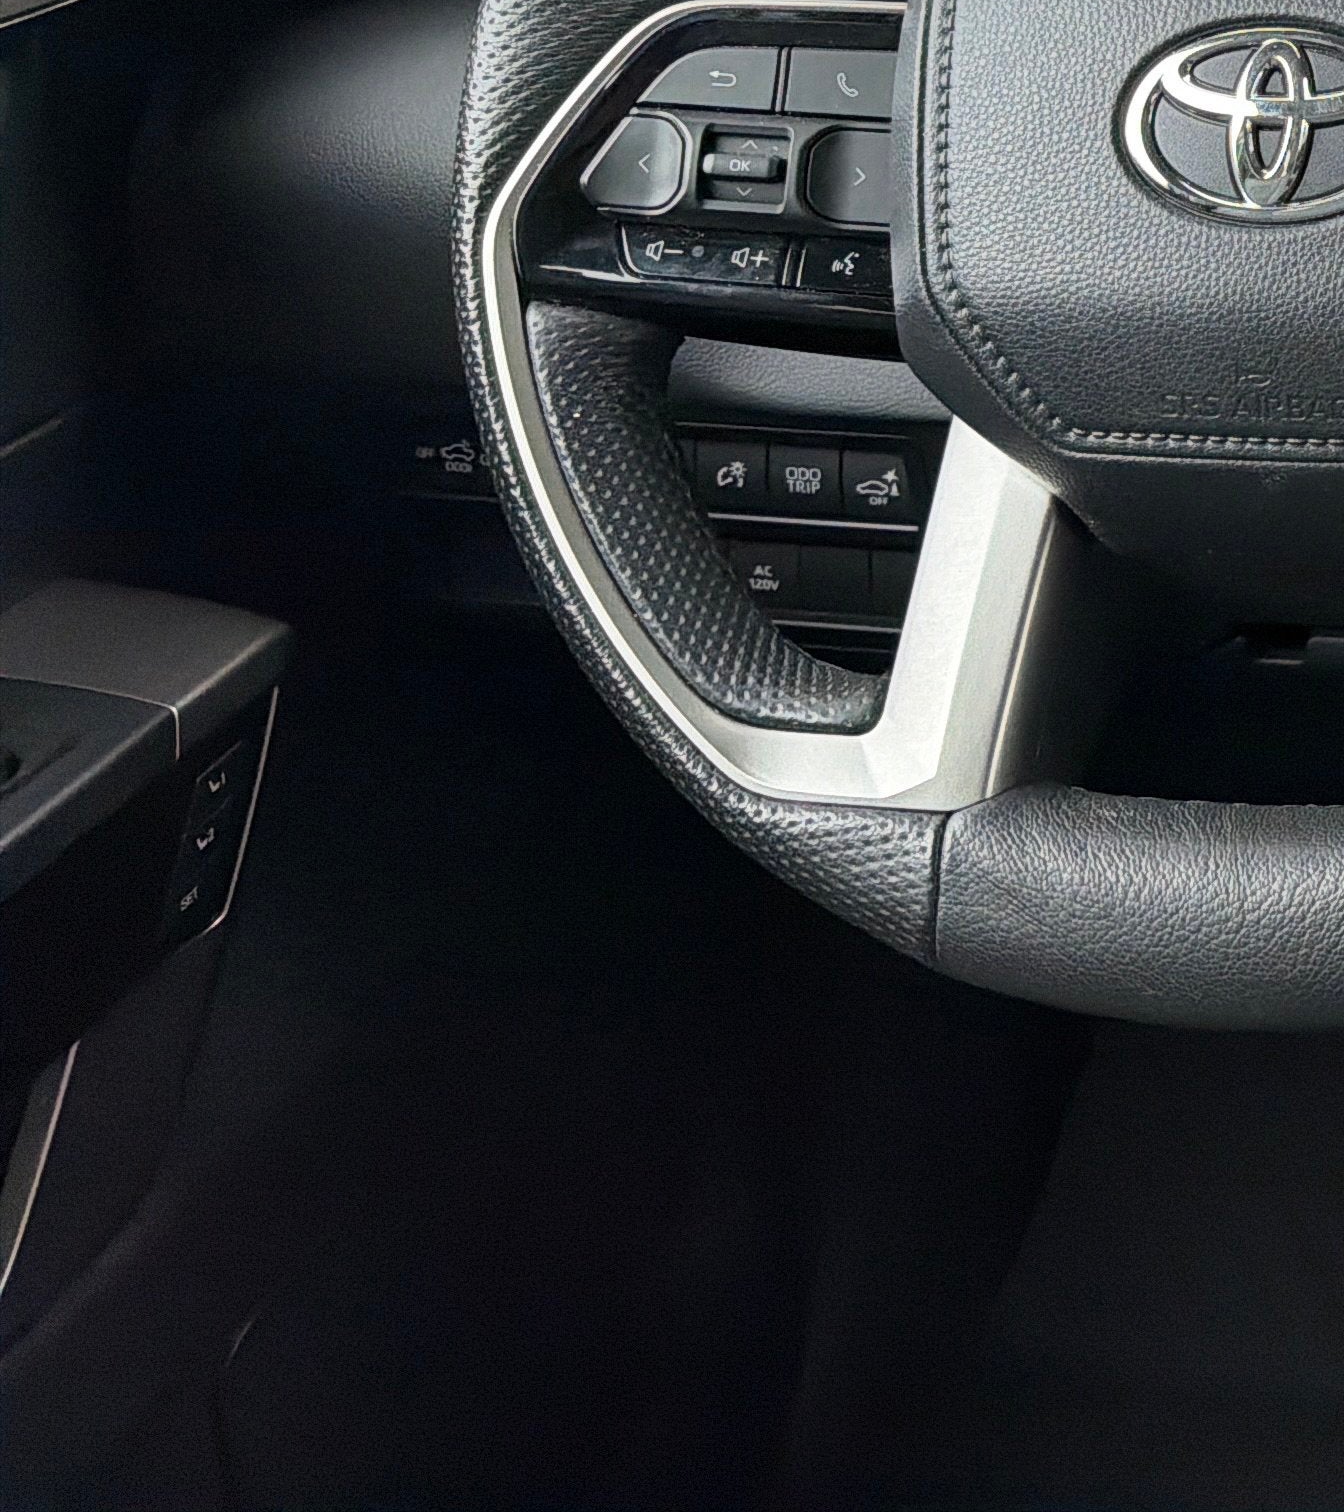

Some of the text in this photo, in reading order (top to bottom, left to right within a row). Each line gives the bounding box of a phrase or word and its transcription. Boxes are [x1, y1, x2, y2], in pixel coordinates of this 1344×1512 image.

[729, 159, 751, 172] OK
[785, 479, 821, 494] TRIP
[753, 564, 774, 578] AC
